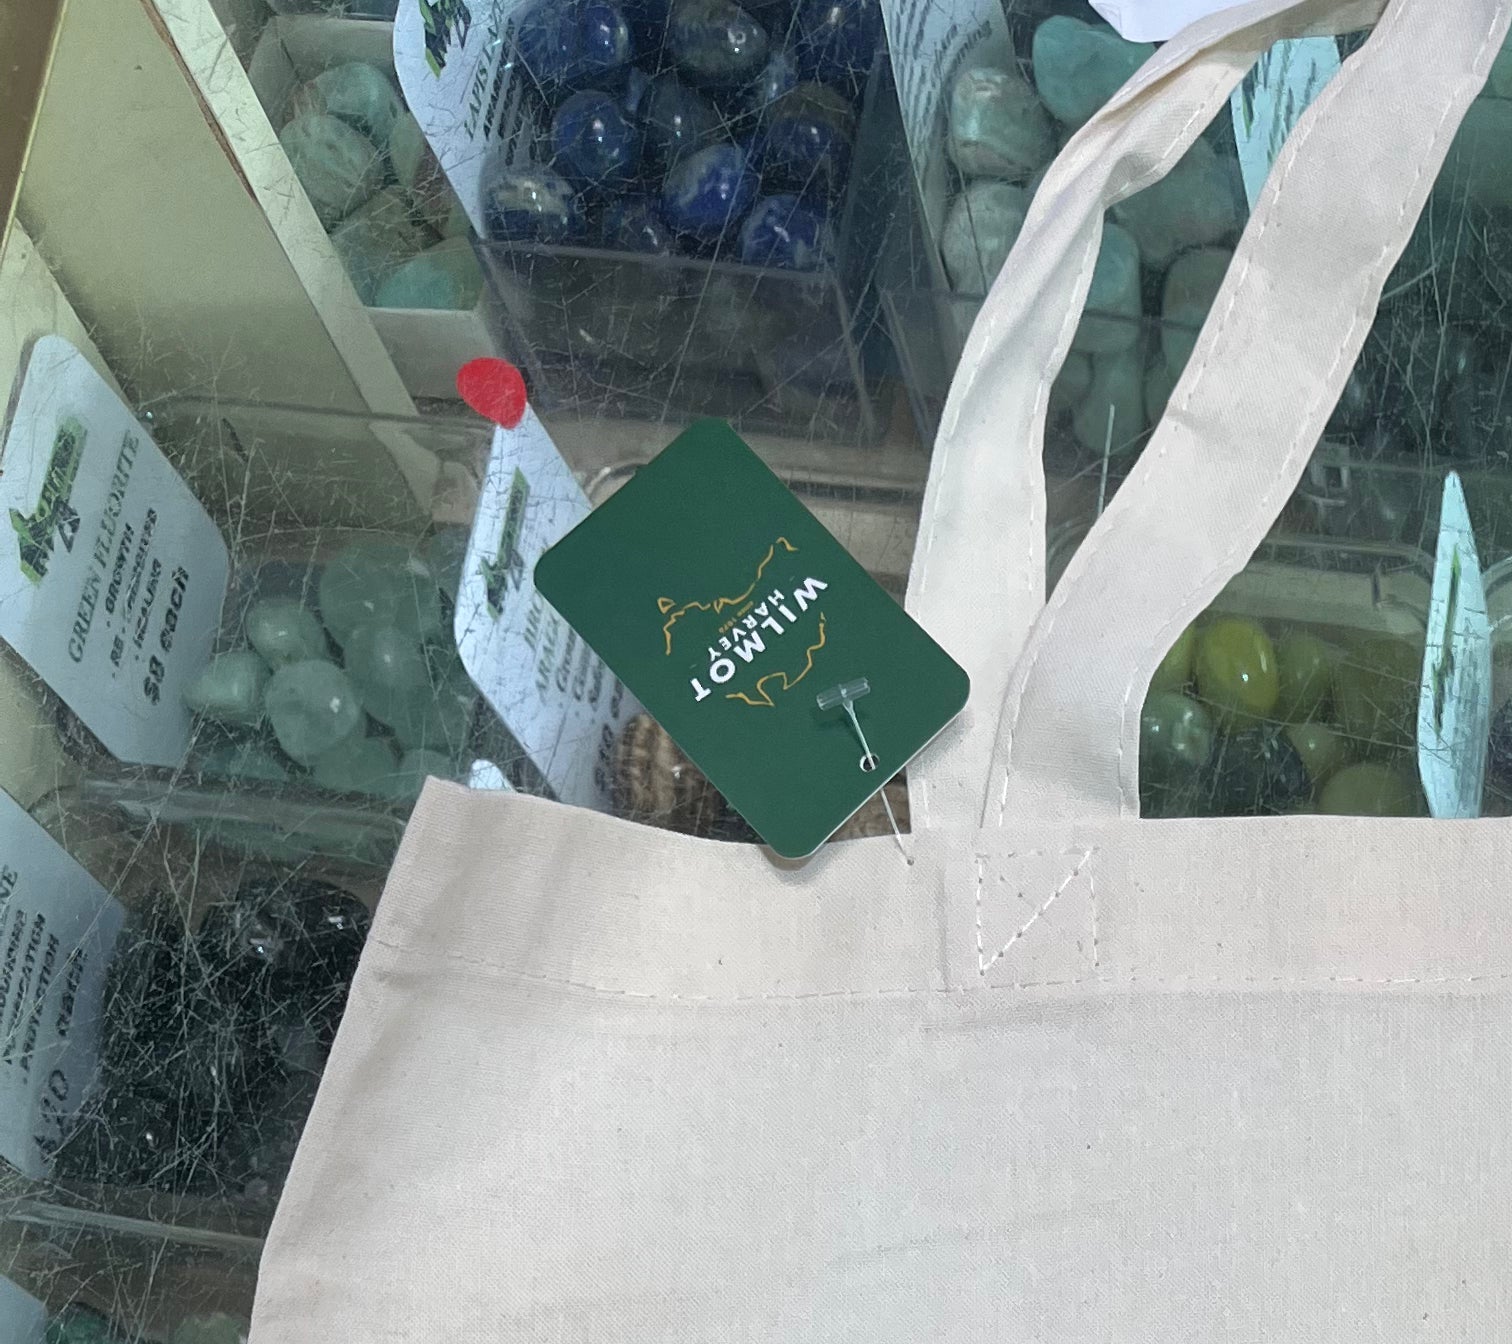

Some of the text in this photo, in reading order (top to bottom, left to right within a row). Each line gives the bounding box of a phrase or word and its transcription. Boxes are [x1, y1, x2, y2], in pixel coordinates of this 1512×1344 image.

[68, 429, 139, 663] GREEN FLUORITE
[690, 577, 828, 702] WILMOT
[708, 588, 785, 662] HARVEY
